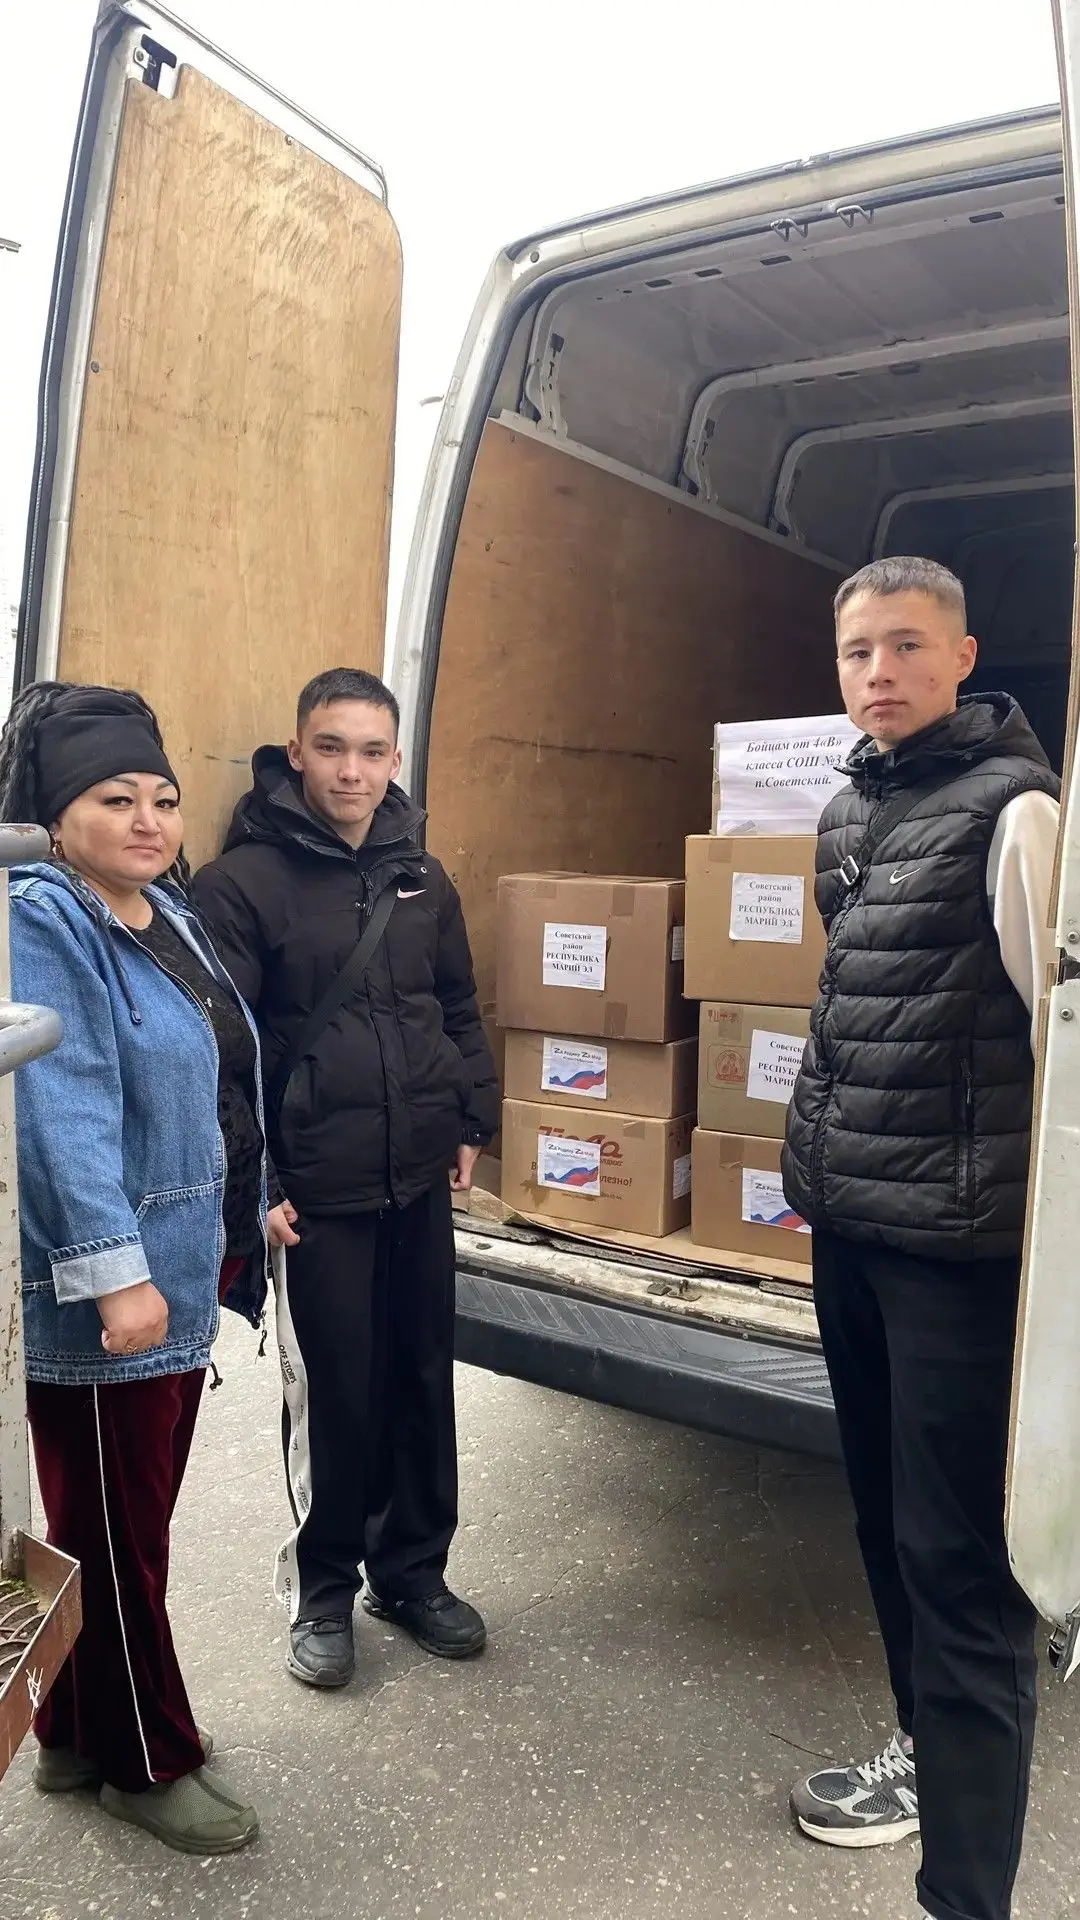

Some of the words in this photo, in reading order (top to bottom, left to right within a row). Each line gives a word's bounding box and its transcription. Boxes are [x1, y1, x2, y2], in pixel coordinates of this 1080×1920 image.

[746, 740, 790, 753] Бойцам
[813, 736, 842, 748] 4«В»
[746, 761, 783, 771] класса
[786, 756, 819, 768] СОШ
[822, 755, 842, 766] №3
[749, 881, 792, 891] Советский
[757, 894, 782, 903] район
[738, 904, 801, 917] РЕСПУБЛИКА
[745, 916, 778, 926] МАРИЙ
[780, 919, 793, 927] ЭЛ
[555, 930, 592, 940] Советский
[546, 952, 600, 963] РЕСПУБЛИКА
[552, 963, 581, 971] МАРИЙ
[770, 1040, 802, 1052] Советск
[758, 1062, 796, 1076] РЕСПУБ
[279, 1344, 288, 1359] OFF
